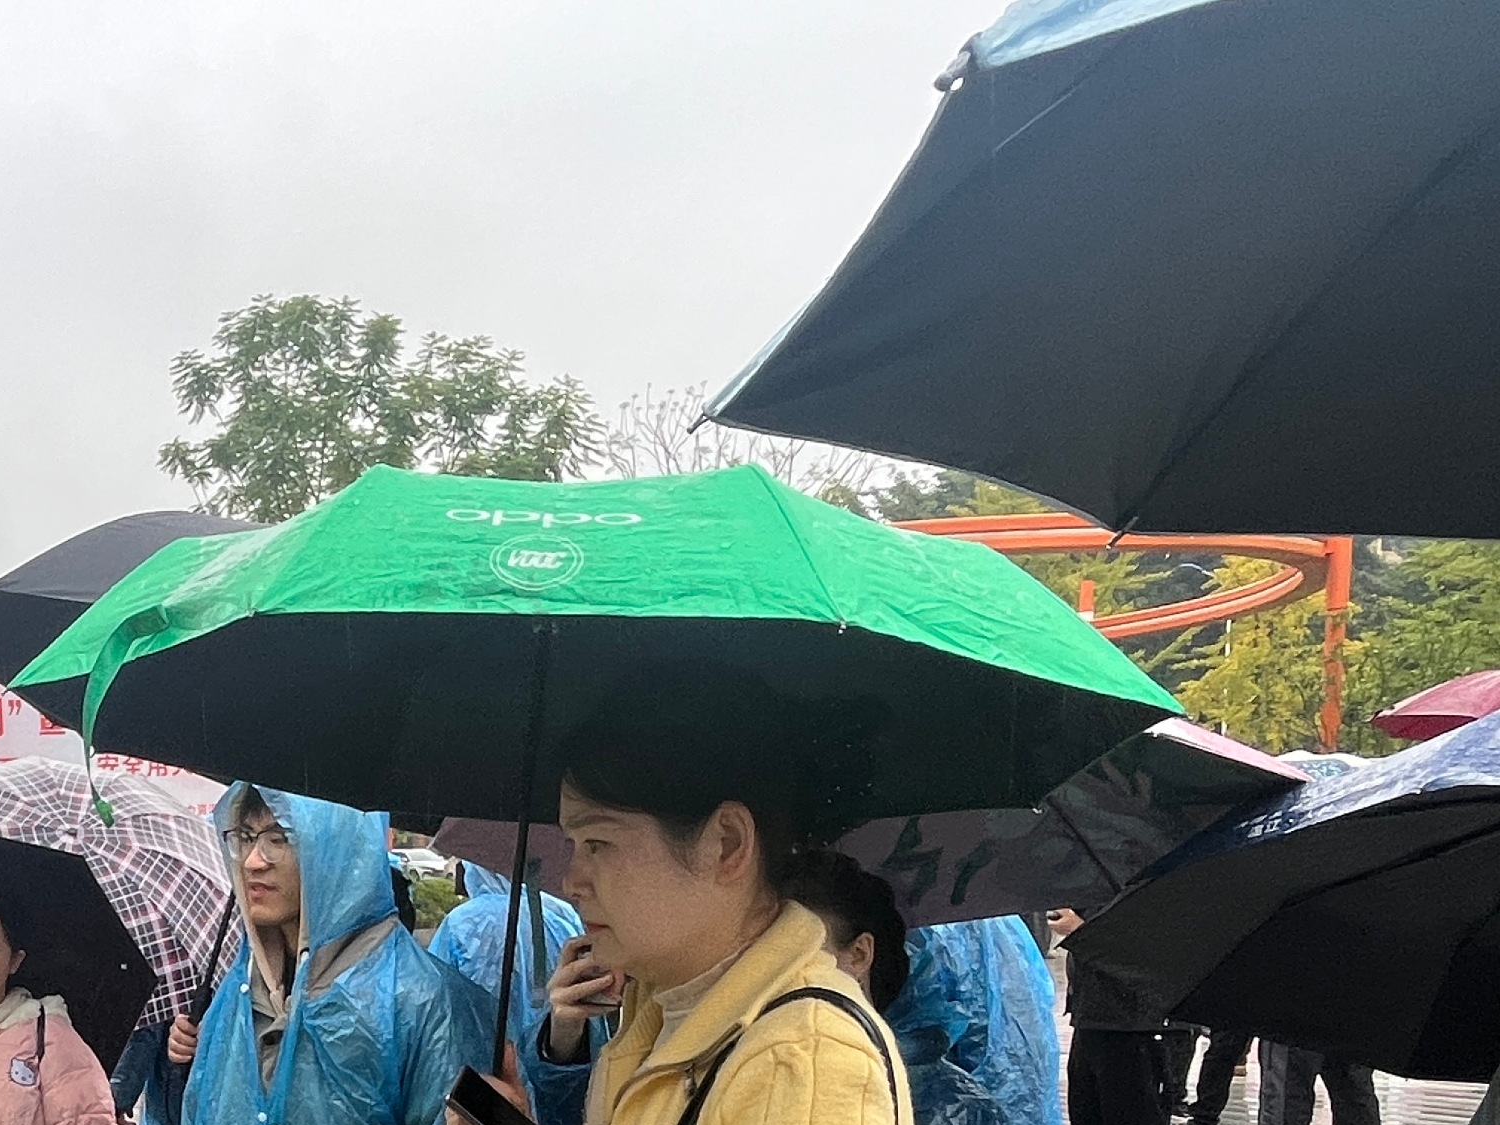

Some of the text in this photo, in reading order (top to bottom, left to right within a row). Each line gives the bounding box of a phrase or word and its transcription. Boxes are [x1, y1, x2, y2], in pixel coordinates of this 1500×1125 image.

[446, 508, 643, 528] oppo
[97, 755, 181, 777] 安全用
